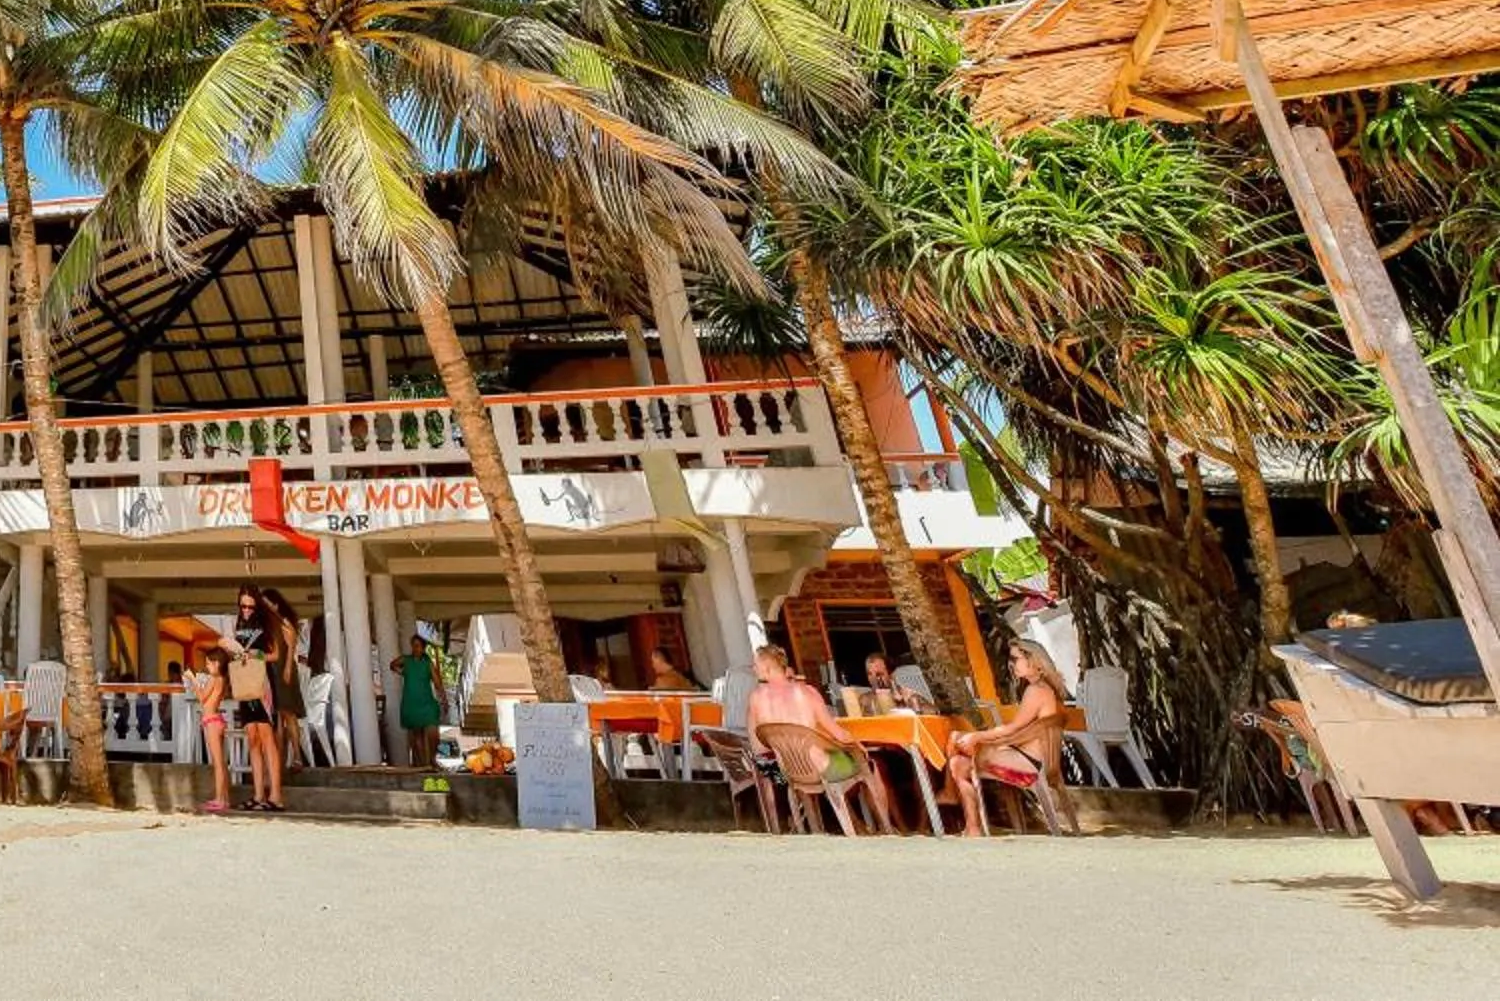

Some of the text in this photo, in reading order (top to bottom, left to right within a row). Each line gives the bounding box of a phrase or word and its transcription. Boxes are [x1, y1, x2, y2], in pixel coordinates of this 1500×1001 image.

[199, 481, 485, 515] DRUKEN MONKE
[326, 514, 370, 532] BAR
